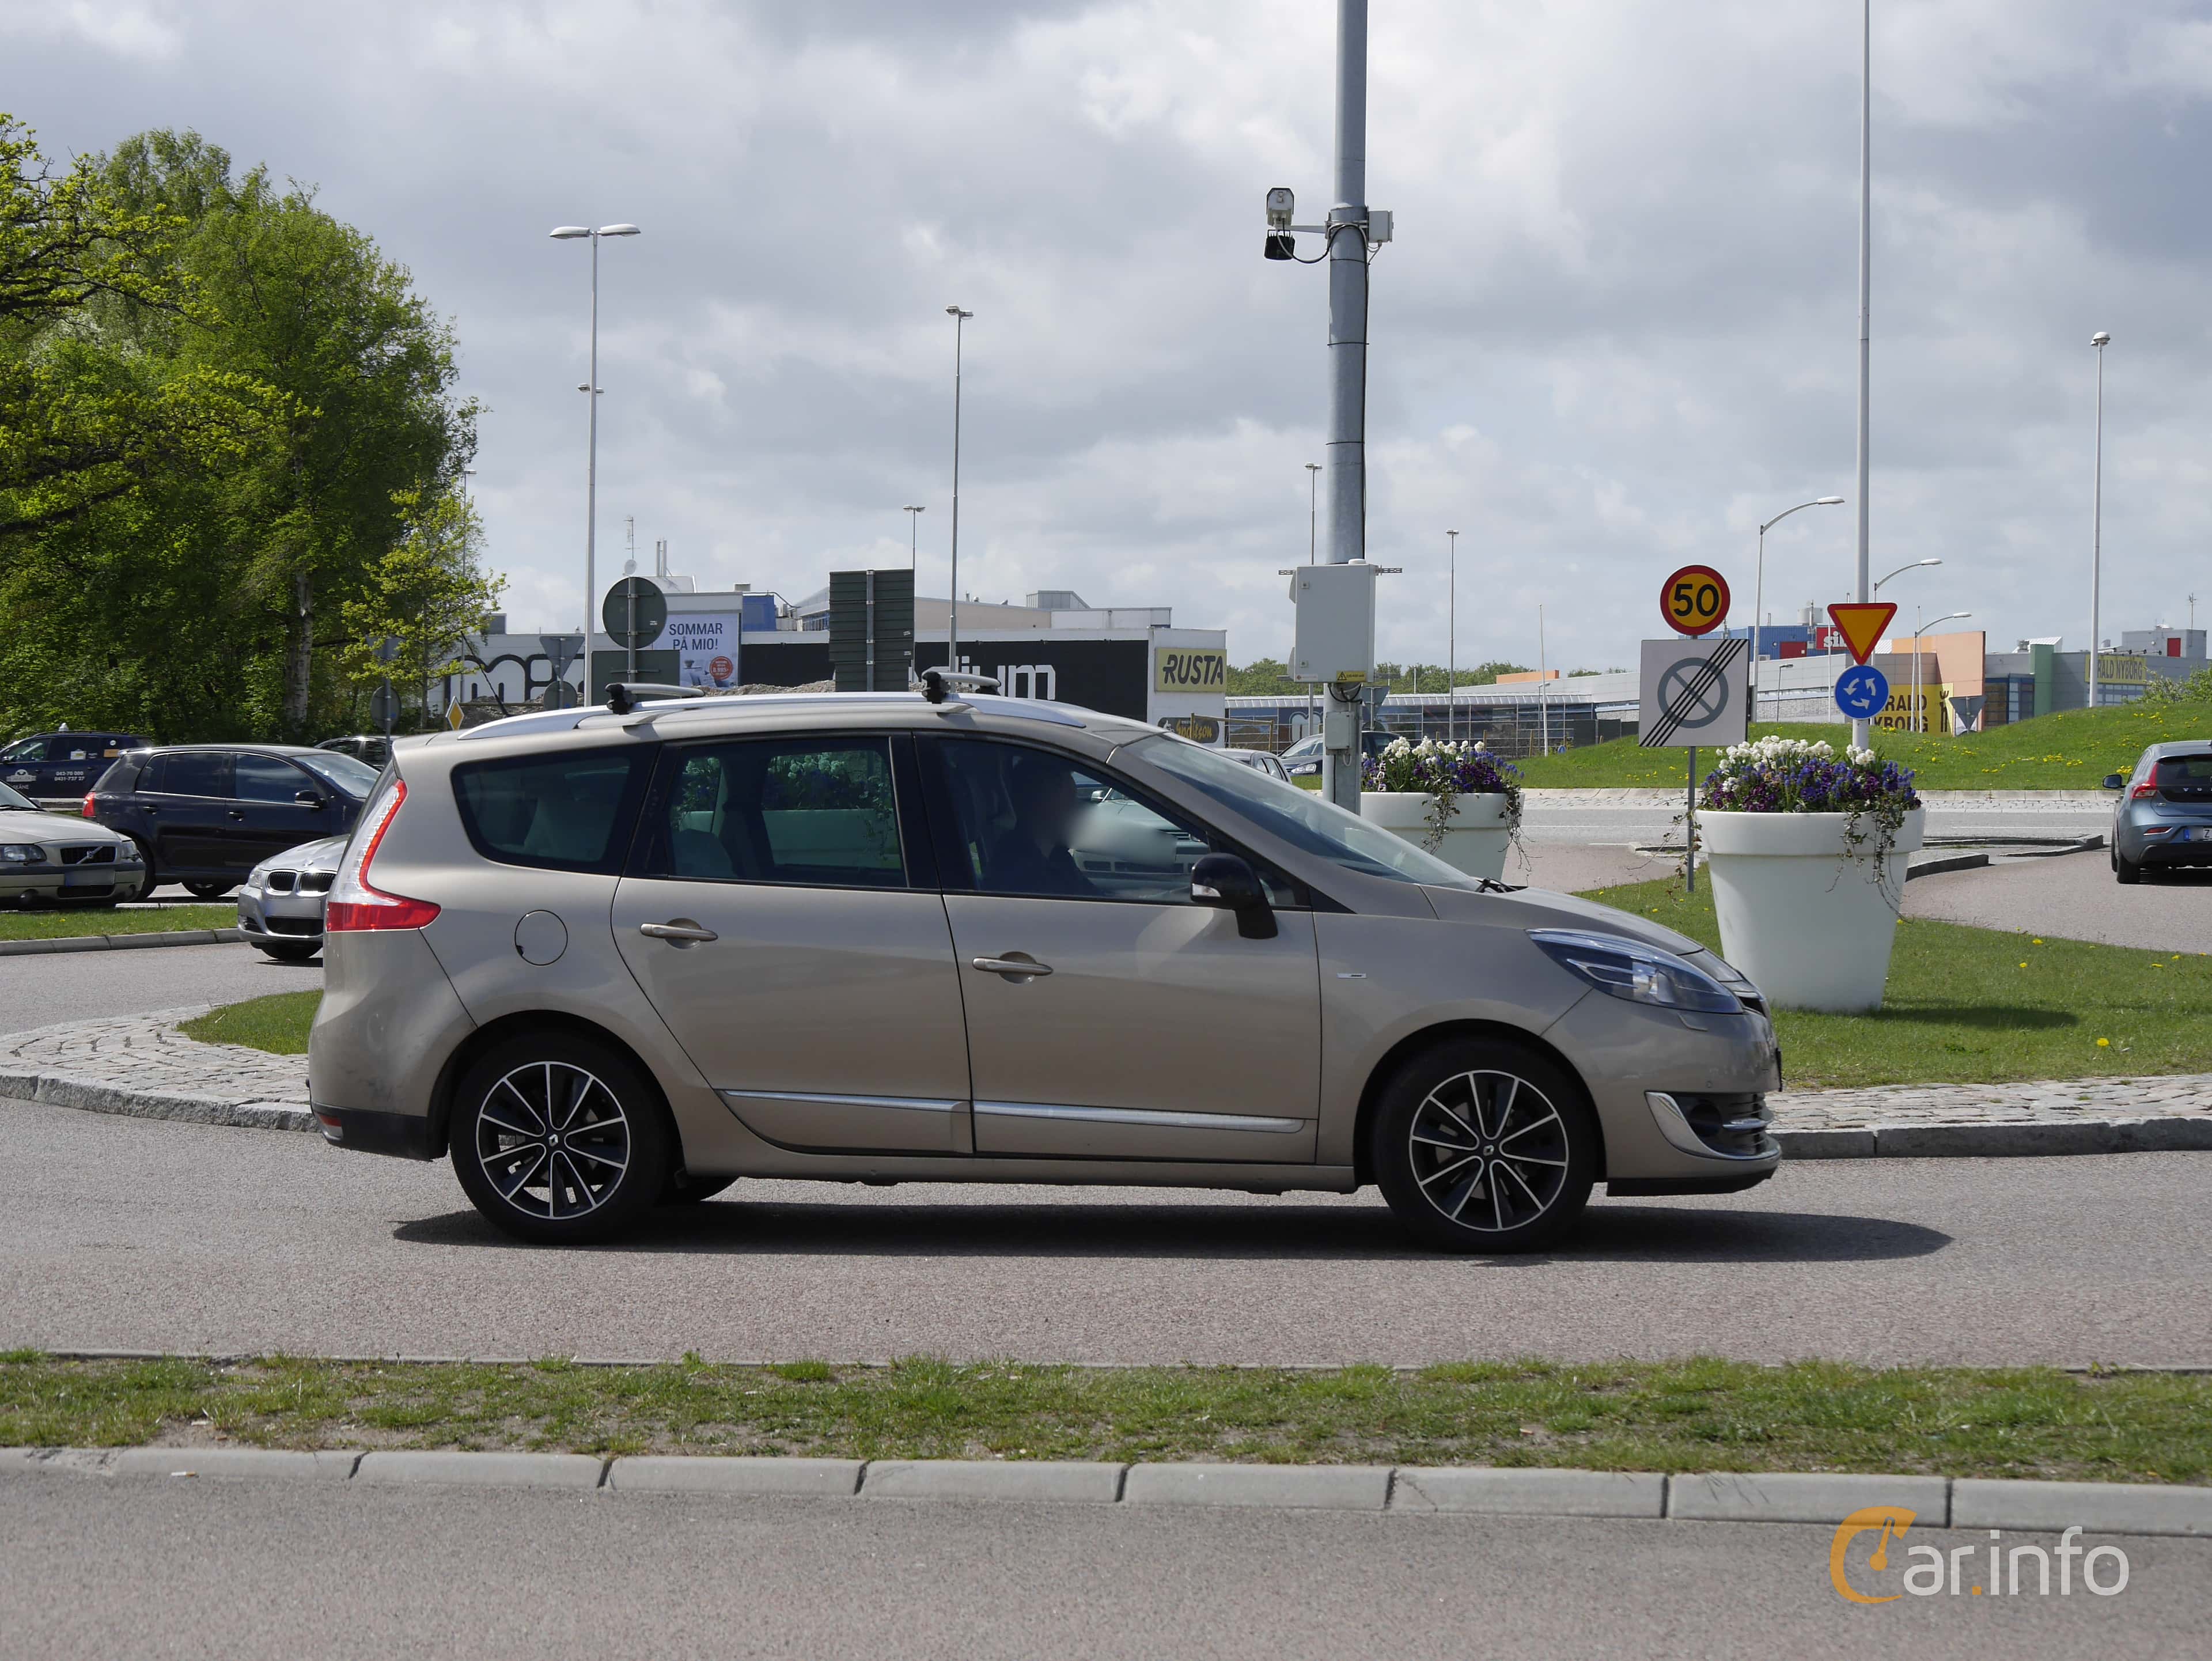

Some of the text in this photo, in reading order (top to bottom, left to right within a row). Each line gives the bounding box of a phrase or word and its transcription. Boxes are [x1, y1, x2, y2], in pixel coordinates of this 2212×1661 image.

[1673, 584, 1719, 616] 50
[669, 623, 722, 635] SOMMAR
[673, 636, 718, 650] PÅ MIO!
[1162, 654, 1224, 684] RUSTA
[2116, 660, 2142, 679] NYBORG
